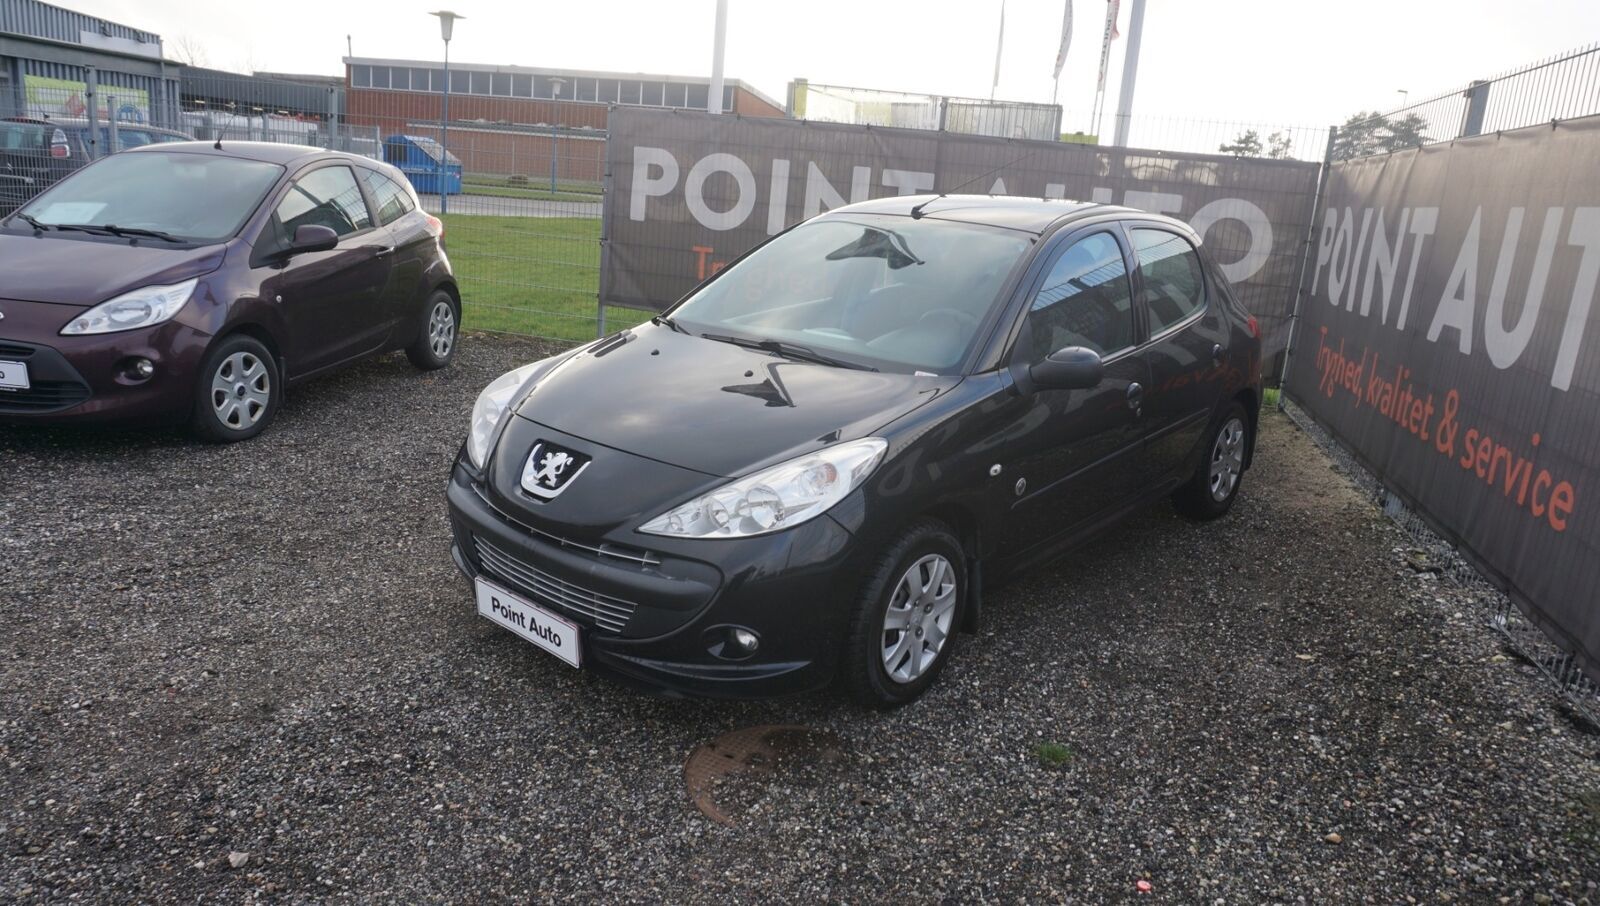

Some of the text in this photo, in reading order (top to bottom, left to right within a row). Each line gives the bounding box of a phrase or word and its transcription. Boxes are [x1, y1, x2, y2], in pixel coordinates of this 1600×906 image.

[1311, 205, 1439, 331] POINT
[1366, 352, 1435, 441] kvalitet
[1435, 389, 1459, 461] &
[1460, 428, 1575, 531] service
[491, 596, 562, 647] Point Auto
